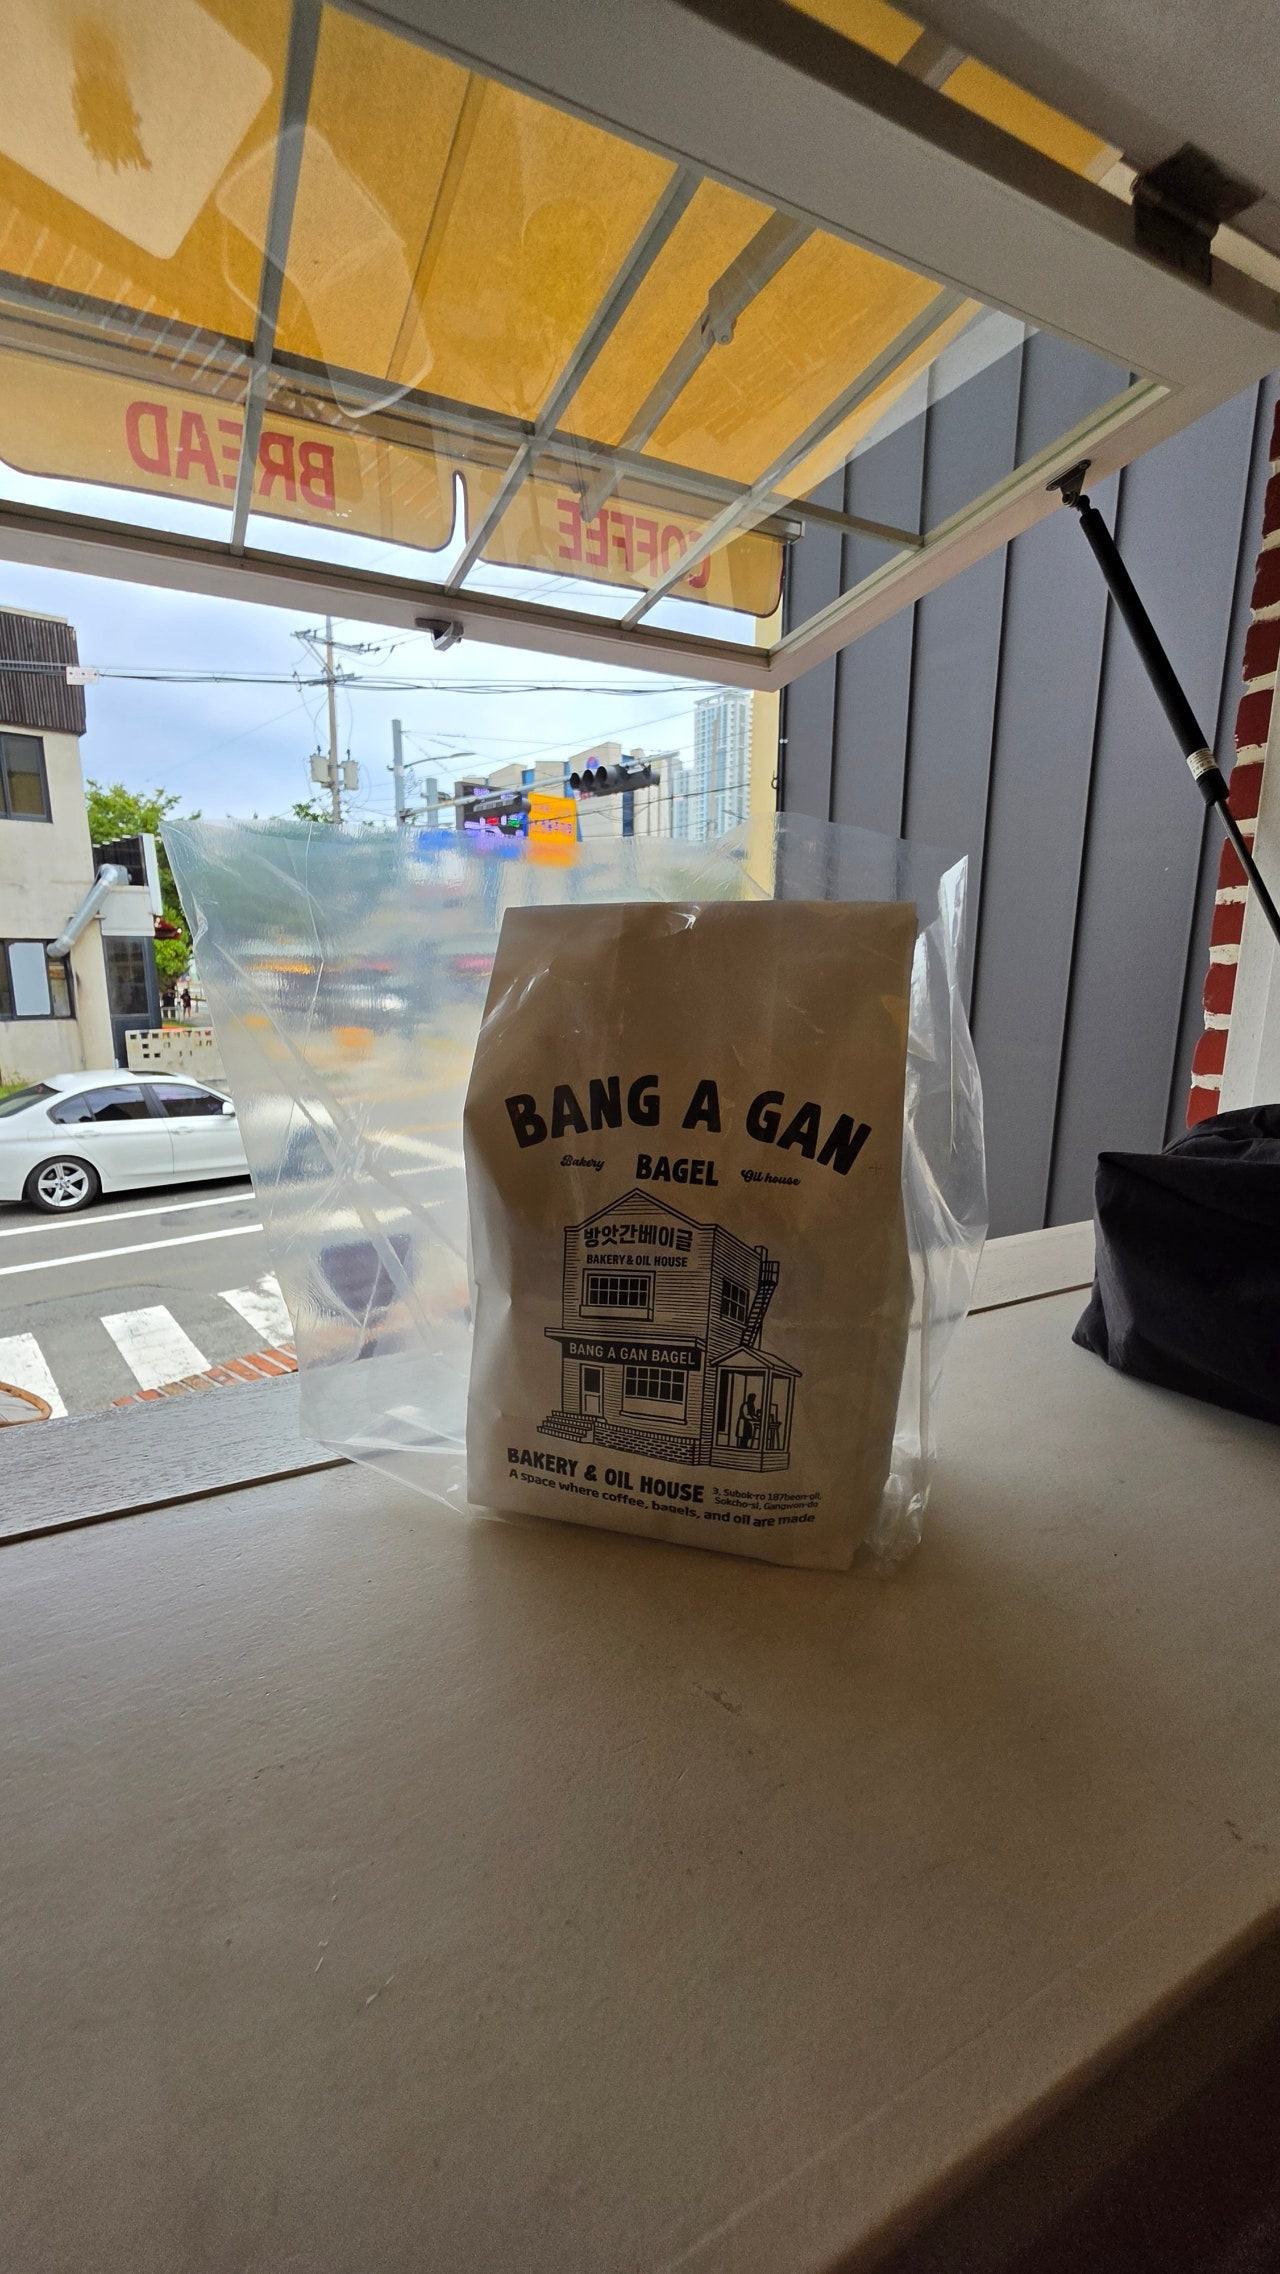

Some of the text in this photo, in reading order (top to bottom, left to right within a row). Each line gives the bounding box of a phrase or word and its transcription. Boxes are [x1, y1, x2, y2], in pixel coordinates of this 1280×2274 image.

[504, 1074, 872, 1175] BANG A GAN
[560, 1154, 605, 1172] Bakery
[635, 1153, 719, 1187] BAGEL
[740, 1169, 801, 1186] Oil house
[583, 1224, 693, 1253] 방앗간베이글
[586, 1254, 688, 1267] BAKERY & OIL HOUSE
[569, 1342, 695, 1365] BANG A GAN BAGEL
[507, 1447, 705, 1503] BAKERY & OIL HOUSE
[509, 1468, 518, 1480] A
[521, 1471, 556, 1489] space
[558, 1482, 600, 1498] where
[602, 1491, 649, 1510] coffee,
[704, 1511, 730, 1523] and
[733, 1514, 751, 1525] oil
[753, 1518, 775, 1528] are
[778, 1513, 816, 1525] made
